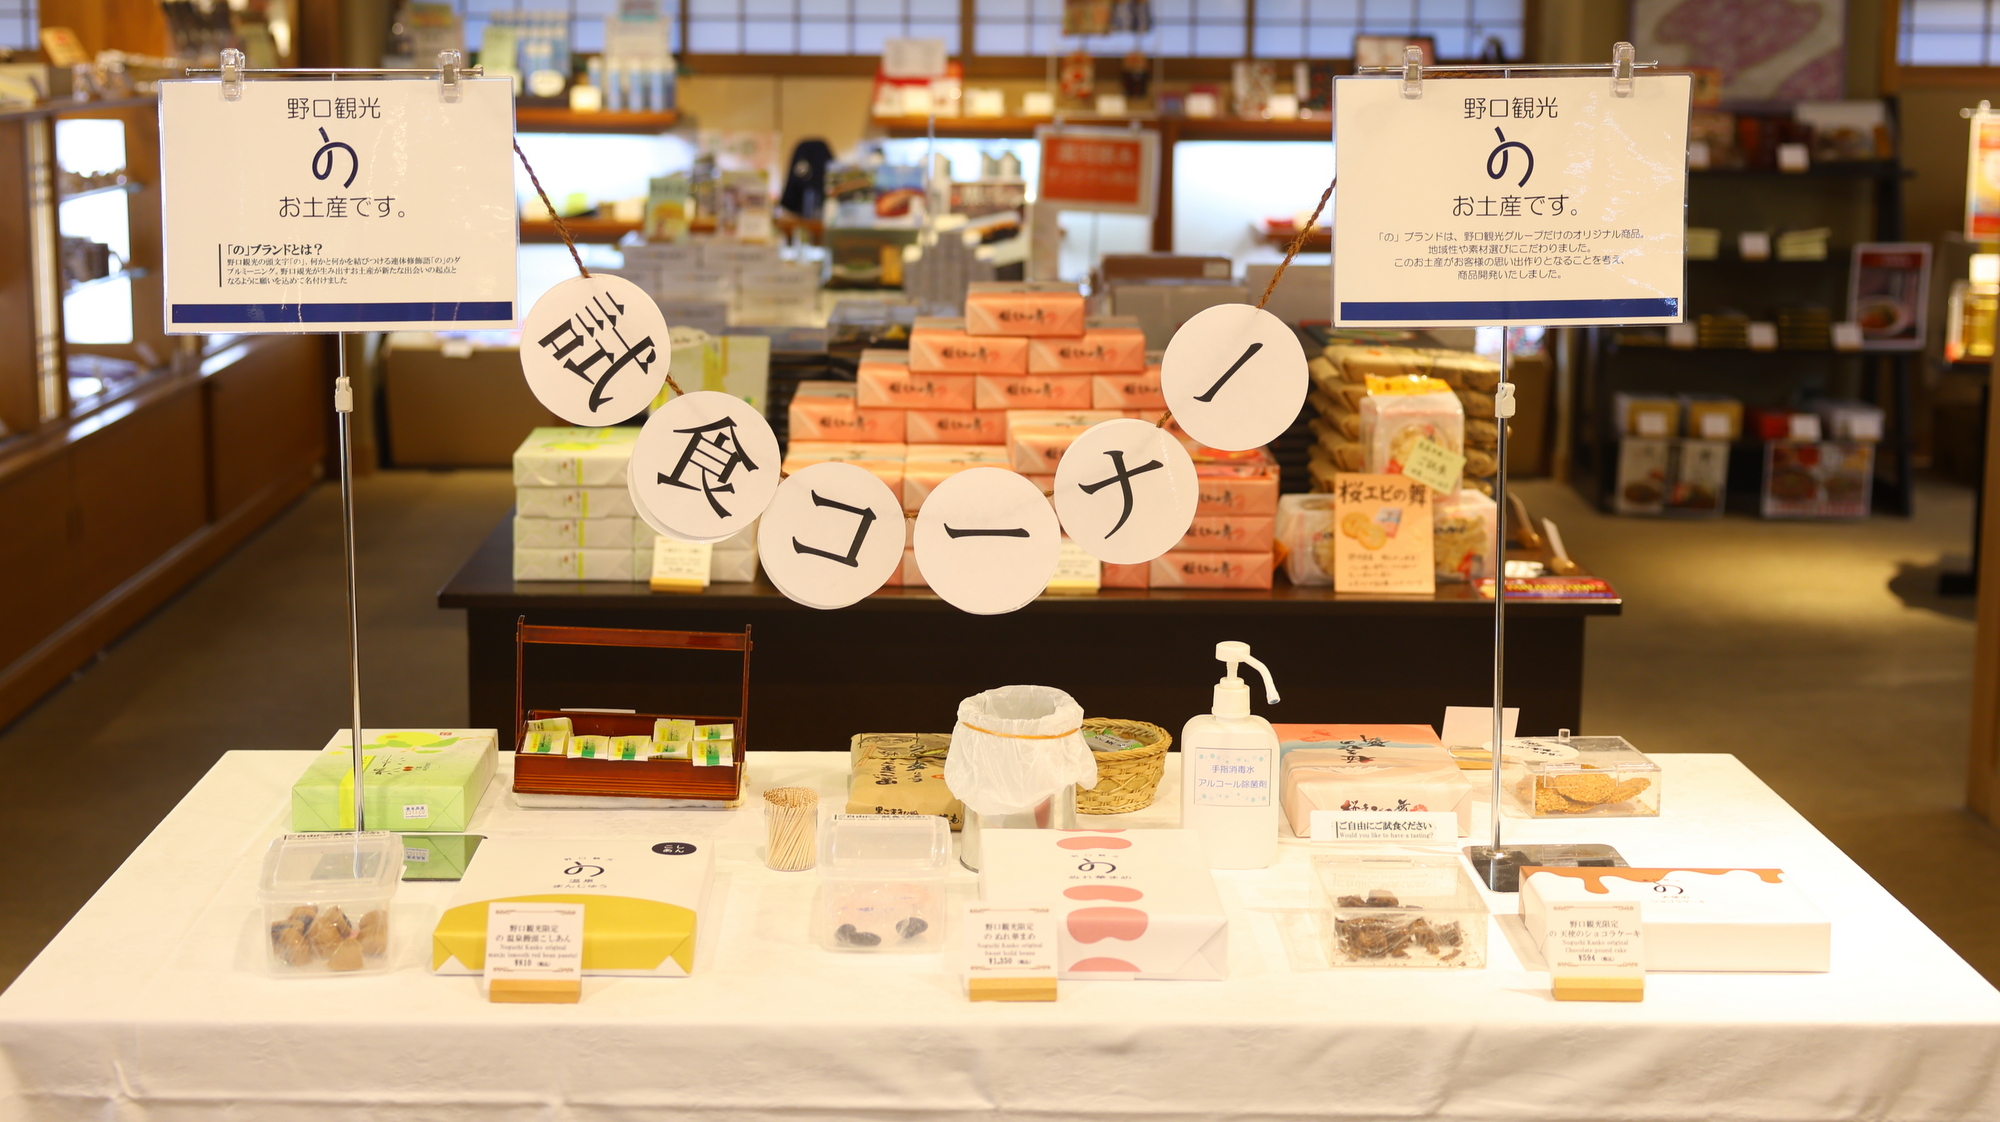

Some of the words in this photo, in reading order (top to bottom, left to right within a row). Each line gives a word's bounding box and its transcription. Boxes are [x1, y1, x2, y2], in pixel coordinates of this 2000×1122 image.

[287, 97, 381, 119] 野口観光
[1464, 96, 1558, 119] 野口観光
[312, 126, 358, 189] の
[1487, 126, 1534, 188] の
[279, 196, 405, 219] お土産です。
[1452, 194, 1578, 217] お土産です。
[1428, 243, 1592, 255] 地域性や素材選びにこだわりました。
[1394, 255, 1625, 268] このお土産がお客様の思い出作りとなることを考え、
[1458, 269, 1562, 280] 商品開発いたしました。
[1339, 480, 1426, 506] 桜エビの舞
[1212, 765, 1254, 774] 手指消毒水
[1198, 779, 1267, 788] アルコール除菌剤
[1339, 821, 1432, 830] ご自由にご試食ください
[1410, 832, 1434, 840] tasting?
[510, 924, 558, 933] 野口観光限定
[986, 923, 1034, 931] 野口観光限定
[1570, 920, 1619, 928] 野口観光限定
[1561, 930, 1641, 938] 天使のショコラケーキ
[1578, 954, 1596, 962] ¥594
